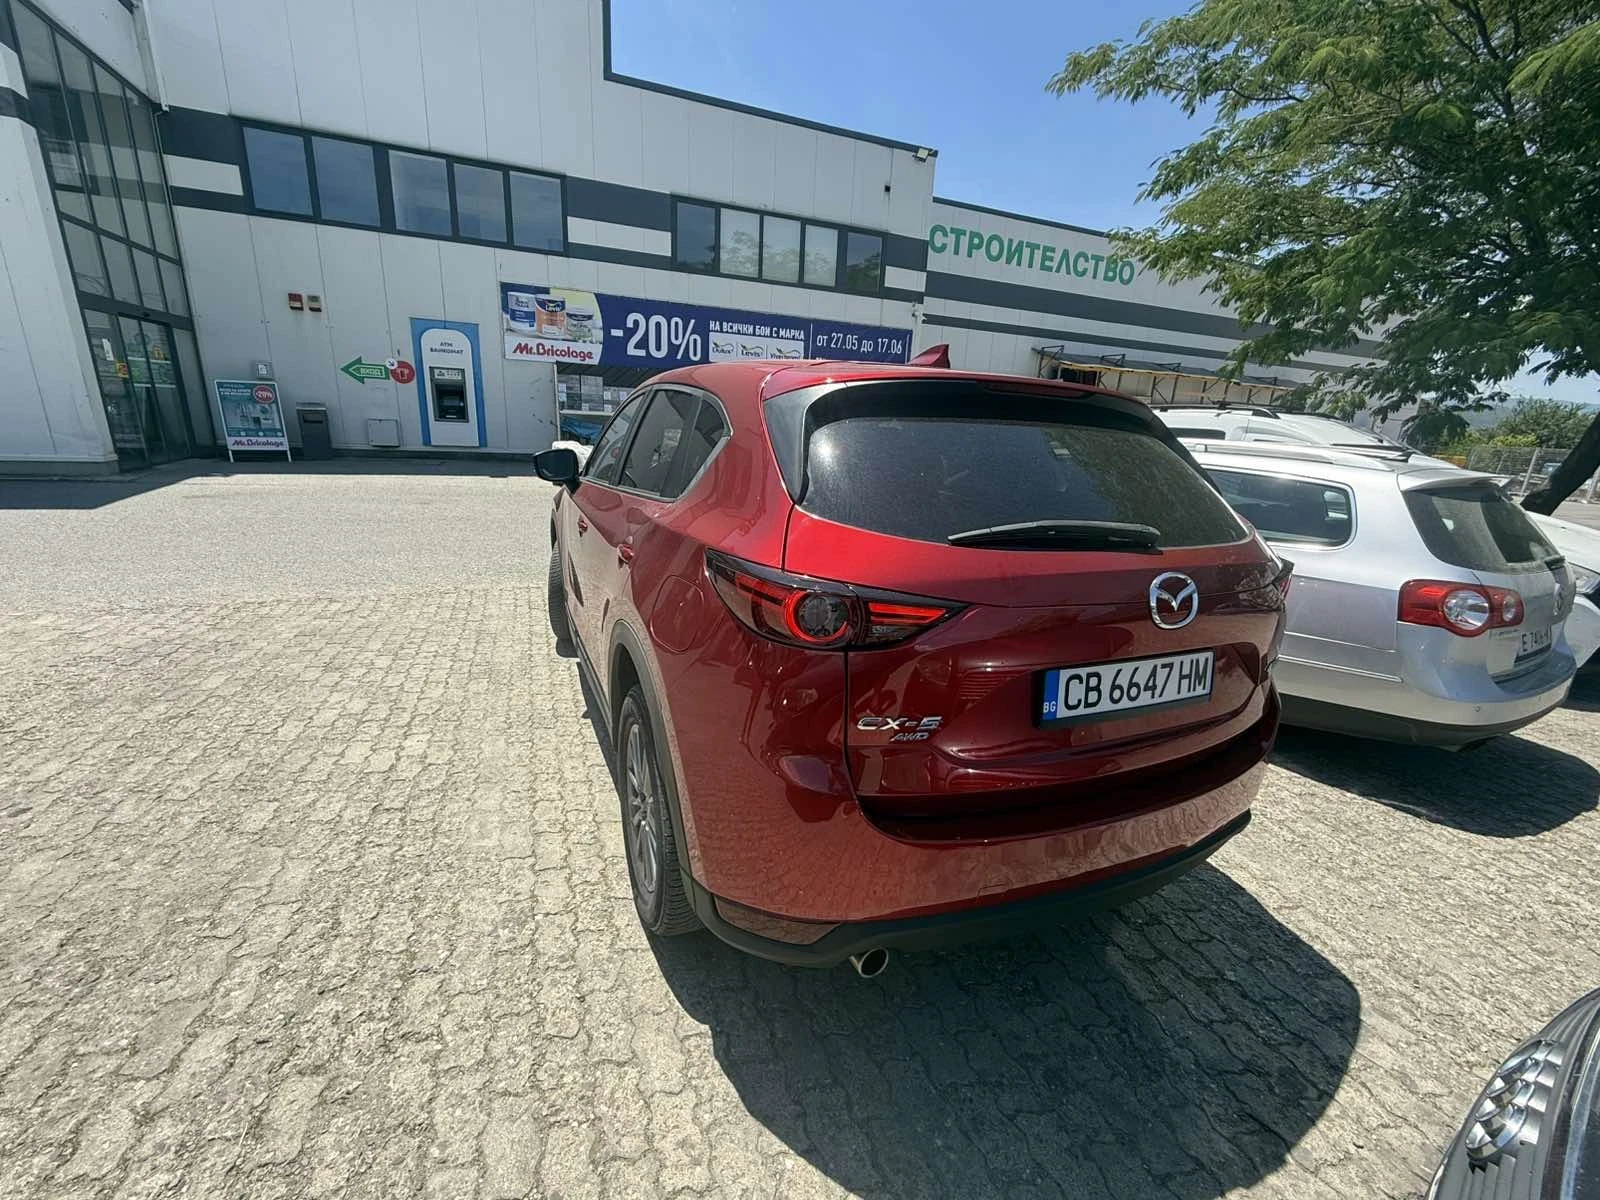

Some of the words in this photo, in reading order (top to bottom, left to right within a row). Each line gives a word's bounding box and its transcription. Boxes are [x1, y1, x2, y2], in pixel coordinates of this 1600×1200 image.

[929, 224, 1135, 286] СТРОИТЕЛСТВО
[610, 312, 701, 361] -20%
[709, 320, 720, 331] НА
[722, 321, 753, 335] ВСИЧКИ
[755, 325, 770, 337] БОИ
[772, 327, 778, 338] С
[779, 328, 804, 340] МАРКА
[512, 342, 594, 362] Mr.Bricolage
[816, 335, 828, 347] от
[830, 332, 858, 350] 27.05
[860, 340, 874, 353] до
[877, 338, 902, 354] 17.06
[1064, 671, 1102, 711] CB
[1109, 662, 1174, 705] 6647
[1177, 656, 1209, 695] HM
[1042, 701, 1057, 713] BG
[856, 716, 943, 730] CX-5
[889, 732, 929, 742] AWD
